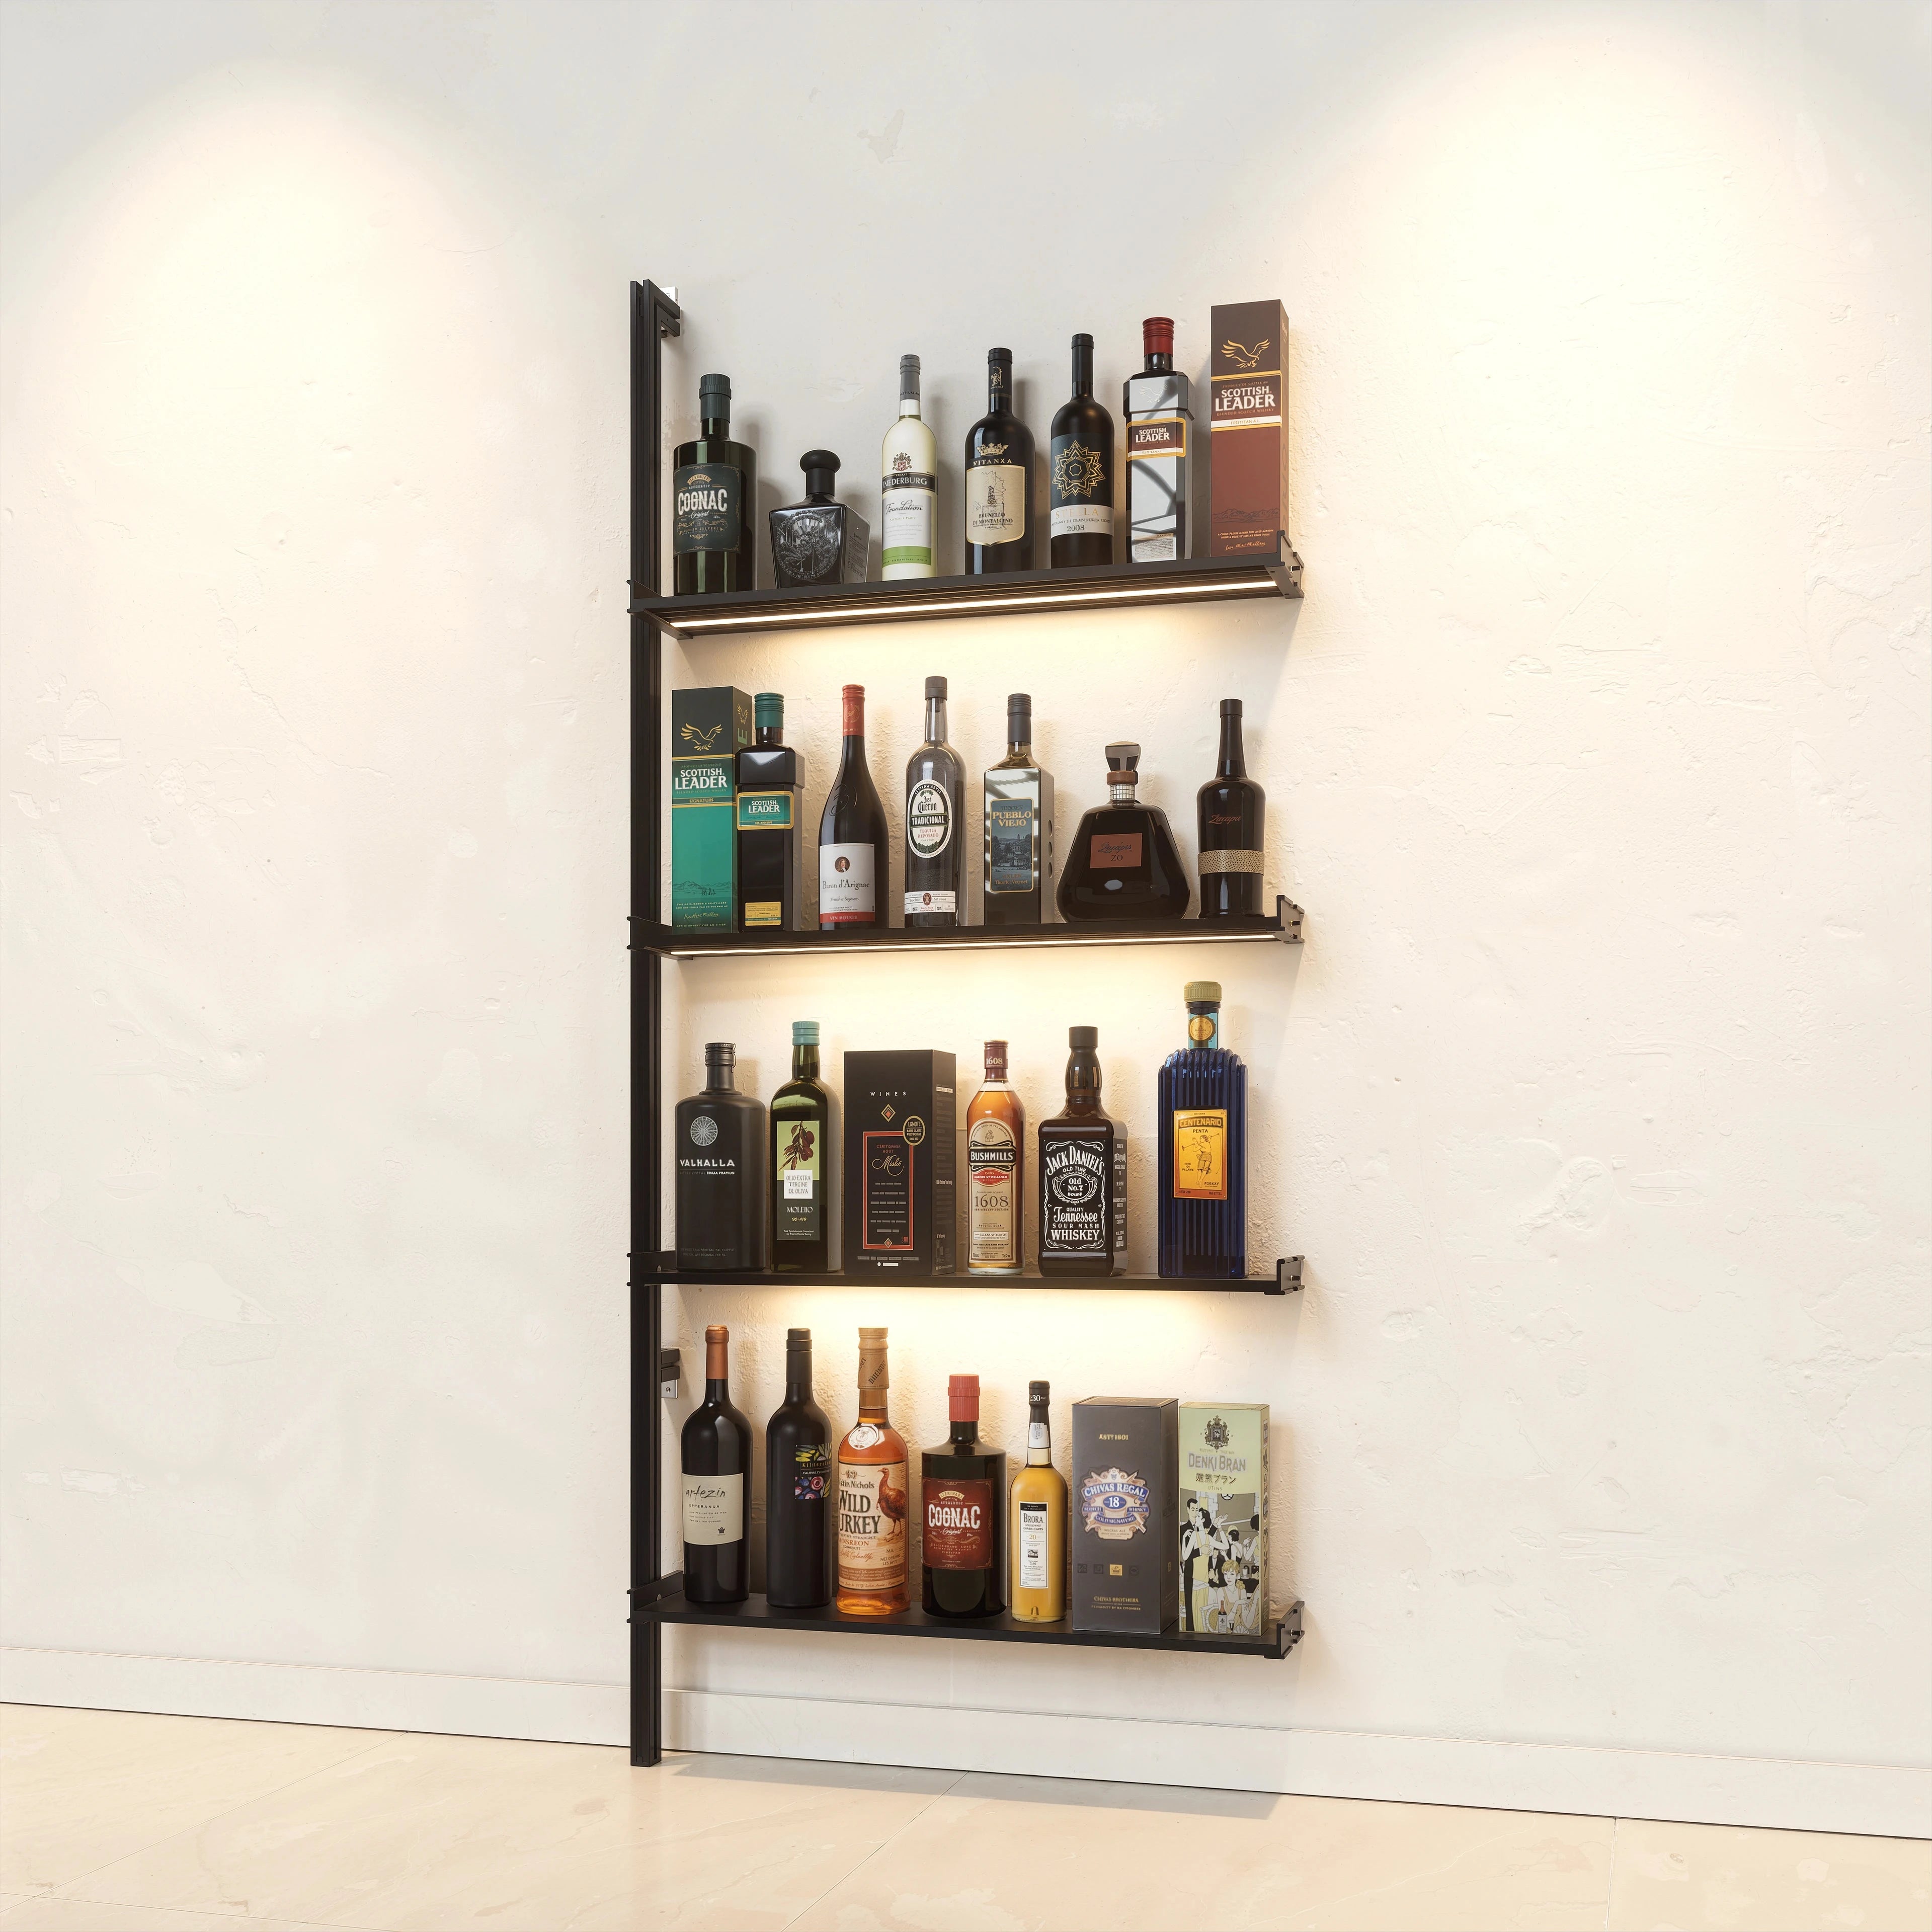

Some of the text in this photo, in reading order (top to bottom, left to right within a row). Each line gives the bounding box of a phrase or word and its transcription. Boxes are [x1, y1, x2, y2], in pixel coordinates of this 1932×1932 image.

[1221, 385, 1269, 398] SCOTTISH
[1215, 394, 1276, 412] LEADER
[1136, 432, 1170, 443] LEADER
[1139, 427, 1167, 435] SCOTTISH
[678, 489, 728, 516] COGNAC
[886, 500, 923, 515] Foundation
[680, 767, 722, 778] SCOTTISH
[675, 775, 728, 790] LEADER
[748, 804, 780, 813] LEADER
[918, 801, 937, 814] Cuervo
[912, 816, 945, 826] TRADICIONAL
[992, 811, 1031, 820] PUEBLO
[998, 819, 1027, 827] VIEJO
[839, 878, 870, 891] d'Arignac
[986, 1056, 1003, 1065] 1608
[1179, 1118, 1222, 1128] CENTENARIO
[971, 1151, 1013, 1160] BUSHMILLS
[1045, 1146, 1105, 1176] JACK DANIEL'S
[680, 1159, 735, 1167] VALHALLA
[974, 1194, 1008, 1208] 1608
[1054, 1206, 1098, 1222] Tennessee
[1051, 1229, 1100, 1240] WHISKEY
[1188, 1453, 1246, 1473] DENKI BRAN
[686, 1485, 726, 1501] artezin
[1084, 1482, 1146, 1498] CHIVAS REGAL
[840, 1490, 871, 1513] WILD
[1108, 1496, 1120, 1508] 18
[928, 1503, 981, 1530] COGNAC
[1023, 1512, 1043, 1523] BRORA
